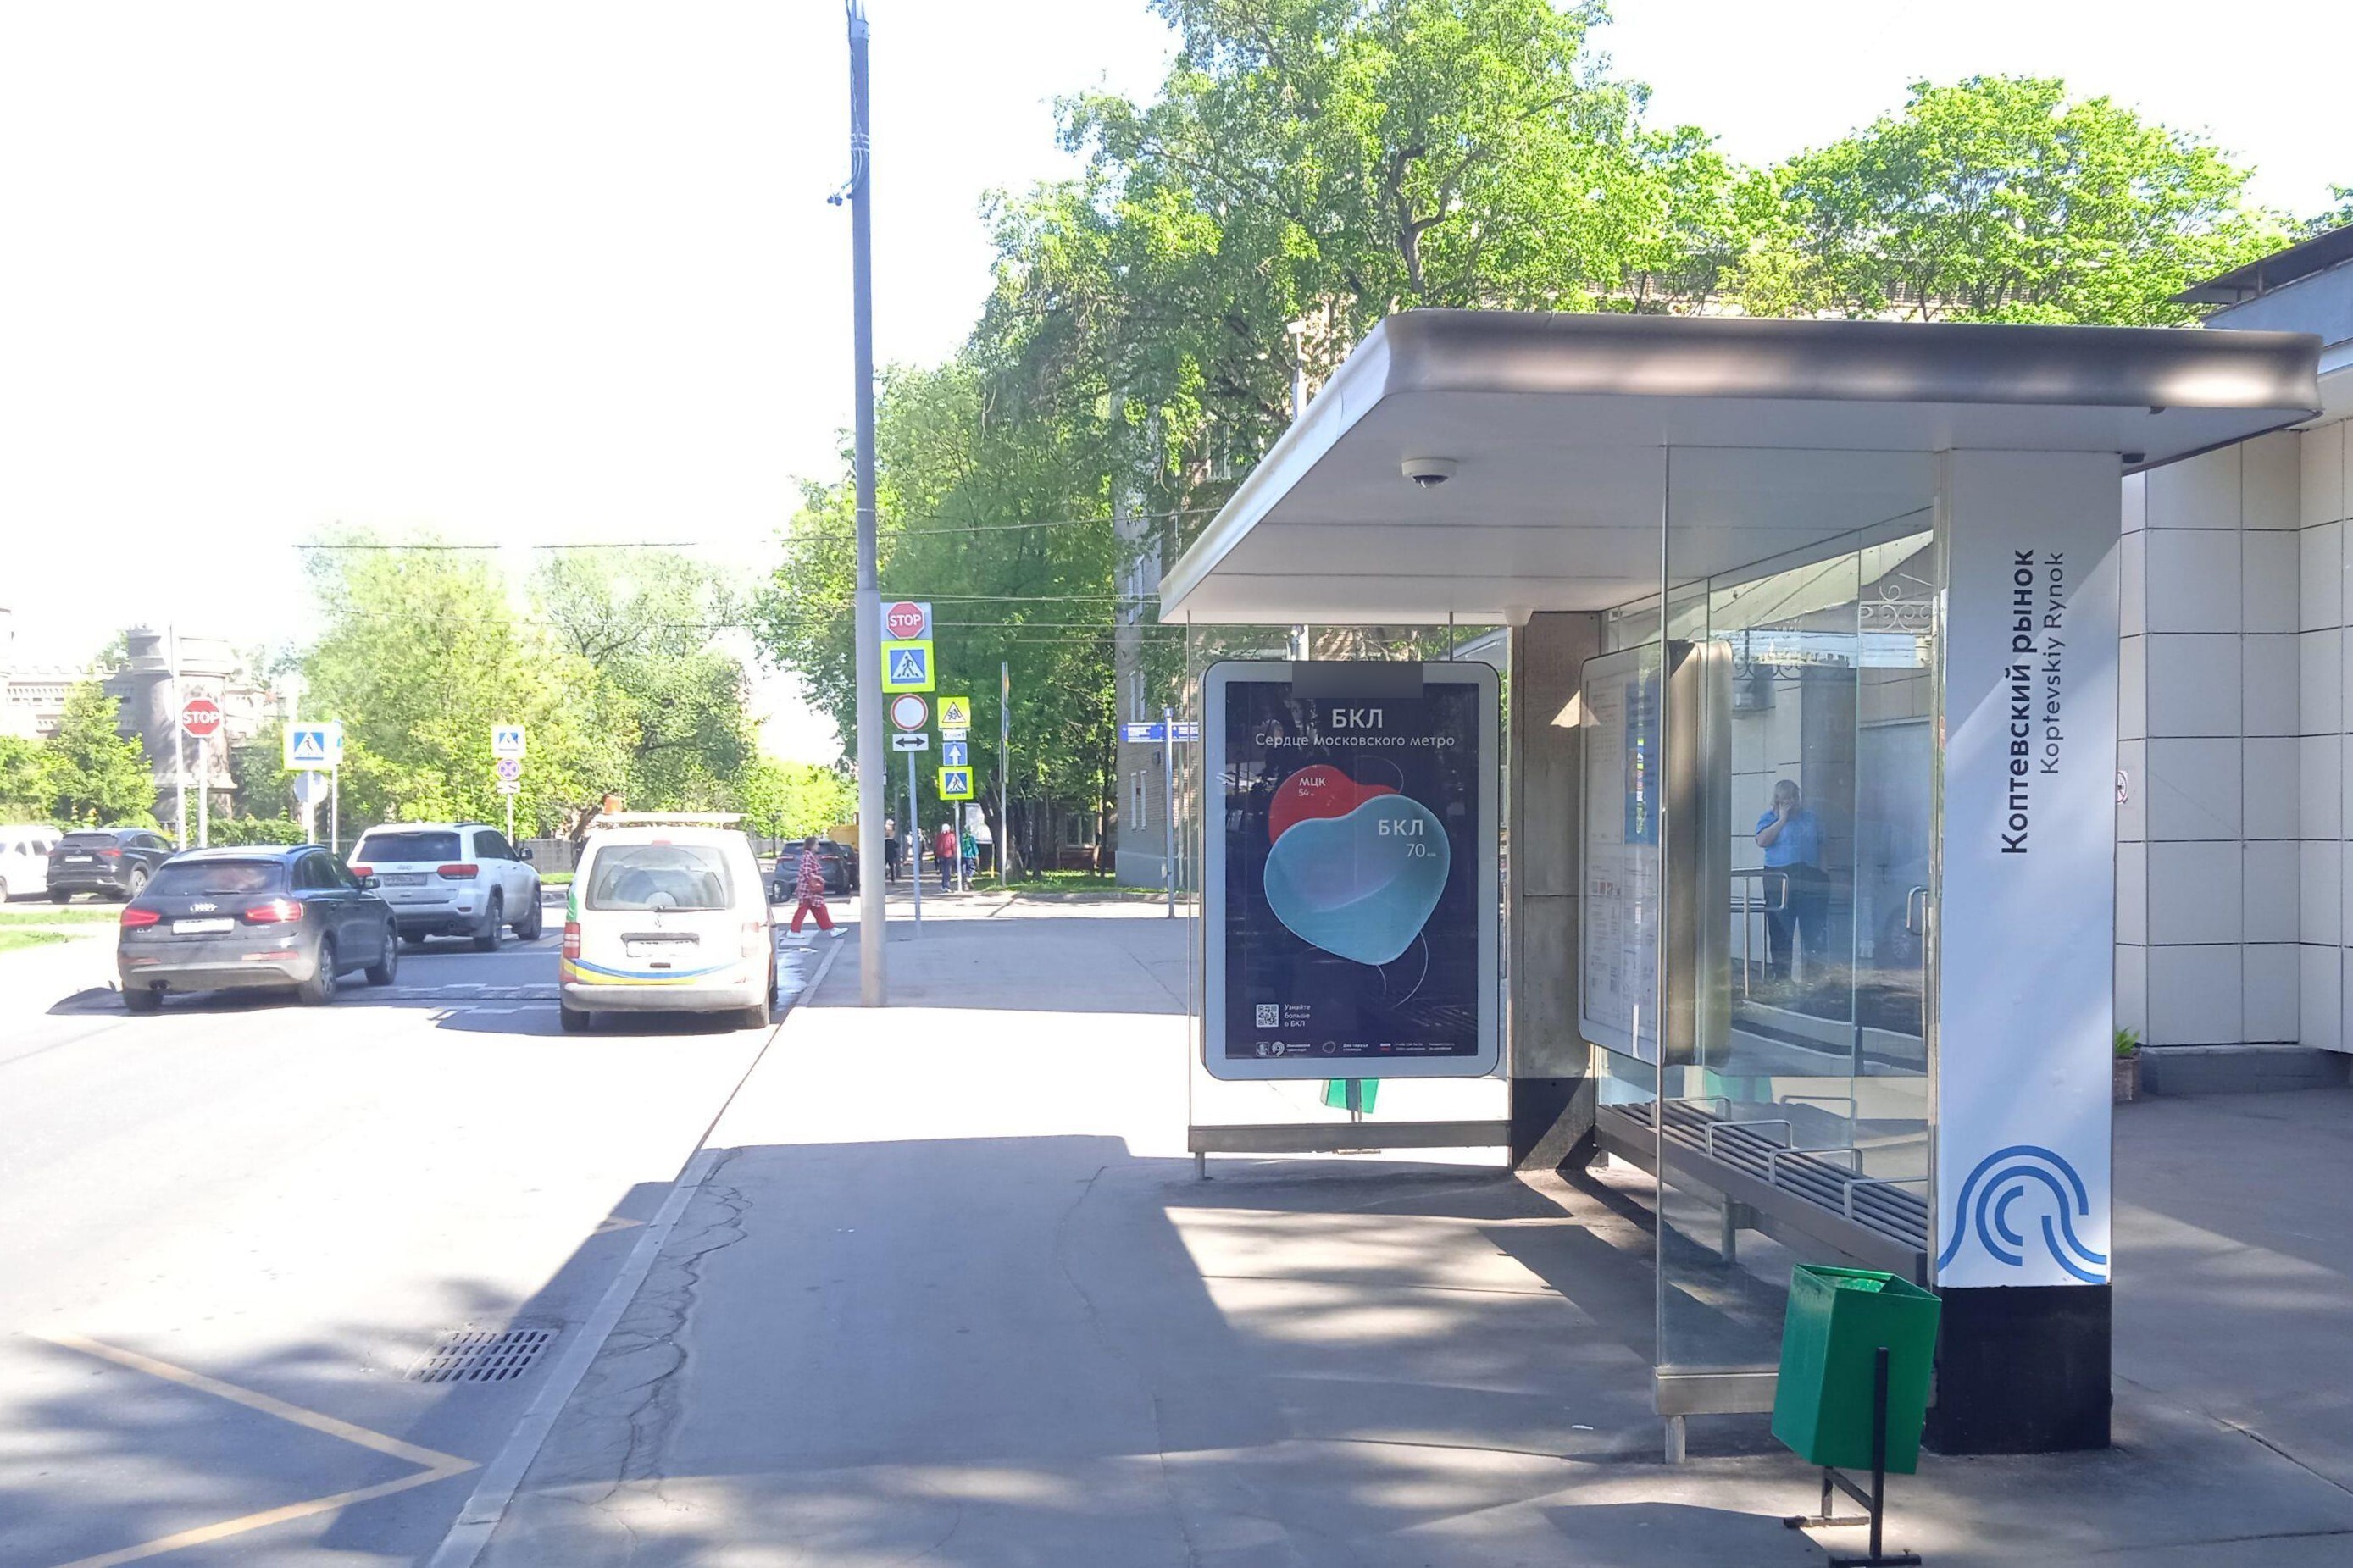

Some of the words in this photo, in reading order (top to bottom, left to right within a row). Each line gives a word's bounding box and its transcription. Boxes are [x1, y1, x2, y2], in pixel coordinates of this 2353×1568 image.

[2043, 551, 2067, 629] Rynok
[2012, 549, 2037, 653] рынок
[890, 613, 922, 627] STOP
[2039, 636, 2066, 774] Koptevskiy
[182, 711, 220, 724] STOP
[1332, 708, 1383, 729] БКЛ
[1255, 733, 1309, 748] Сердце
[1314, 735, 1406, 746] московского
[1410, 735, 1455, 749] метро
[2001, 664, 2031, 854] Коптевский
[1299, 777, 1326, 788] МЦК
[1298, 788, 1309, 797] 54
[1378, 819, 1423, 836] БКЛ
[1406, 843, 1426, 858] 70
